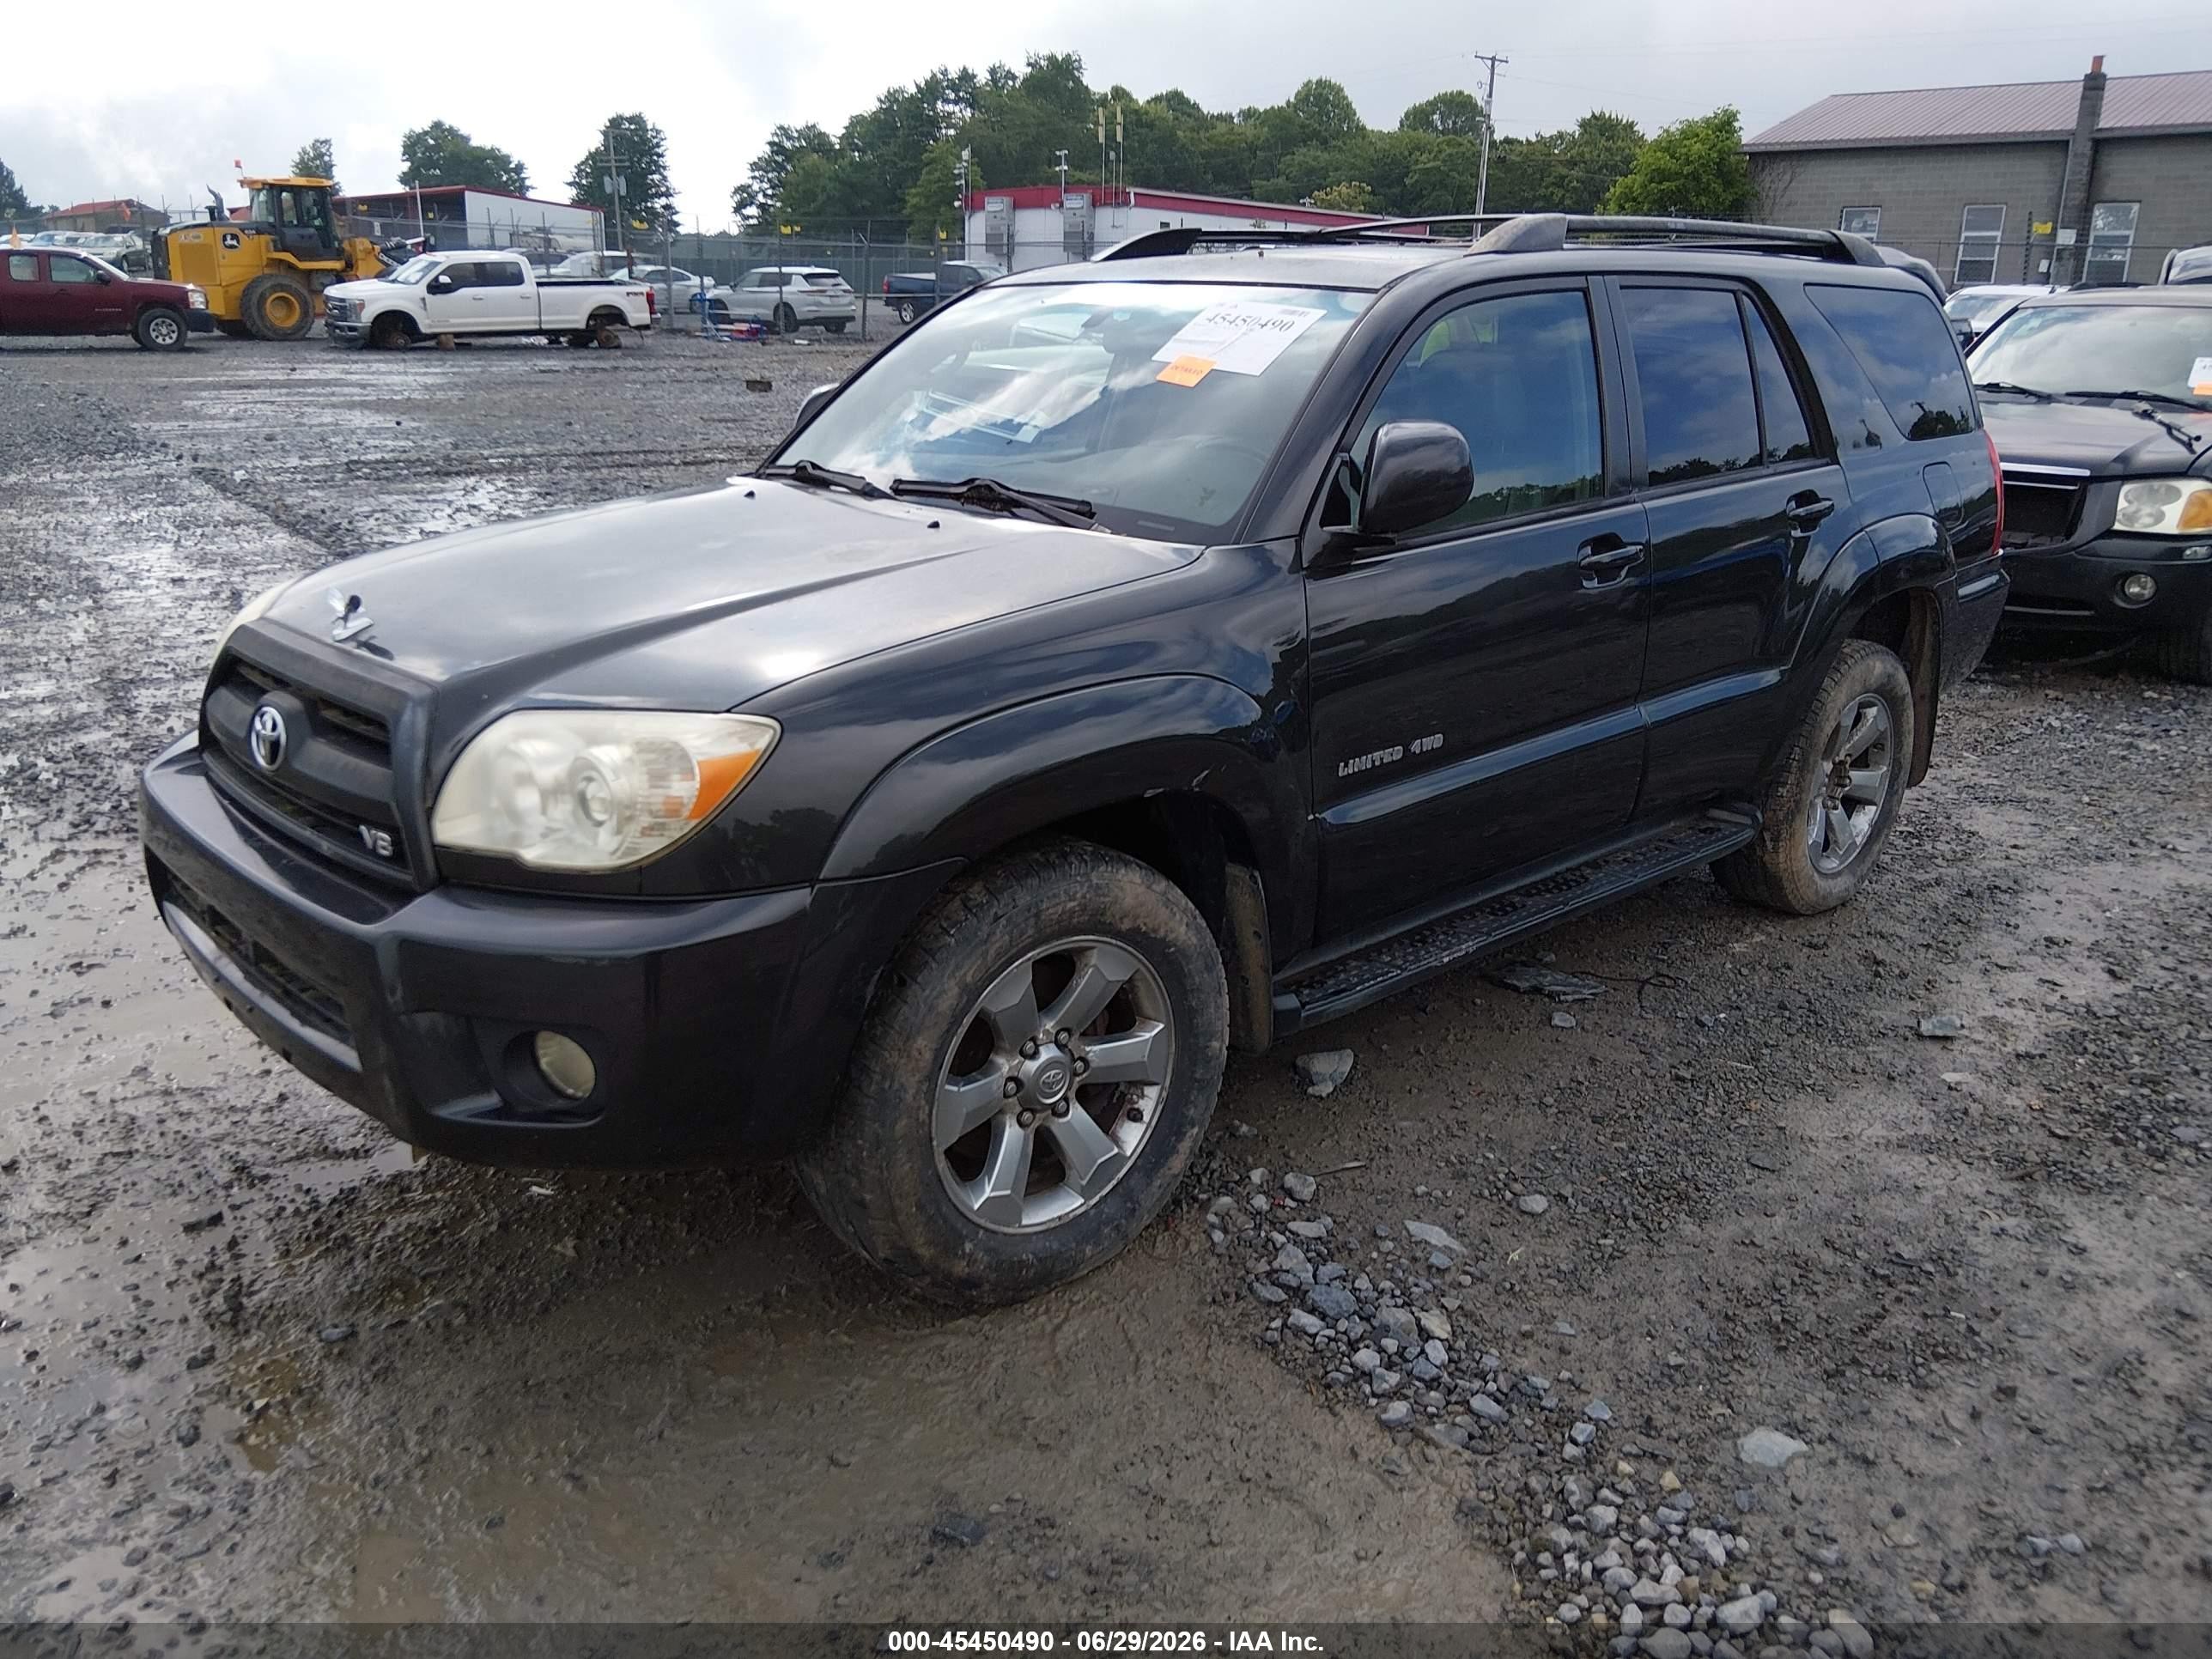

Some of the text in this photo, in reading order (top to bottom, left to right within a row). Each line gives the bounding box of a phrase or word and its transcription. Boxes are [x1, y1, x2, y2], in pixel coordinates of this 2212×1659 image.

[1206, 313, 1295, 332] 45450490
[1339, 733, 1443, 776] LIMITED 4WD
[359, 824, 393, 856] V6
